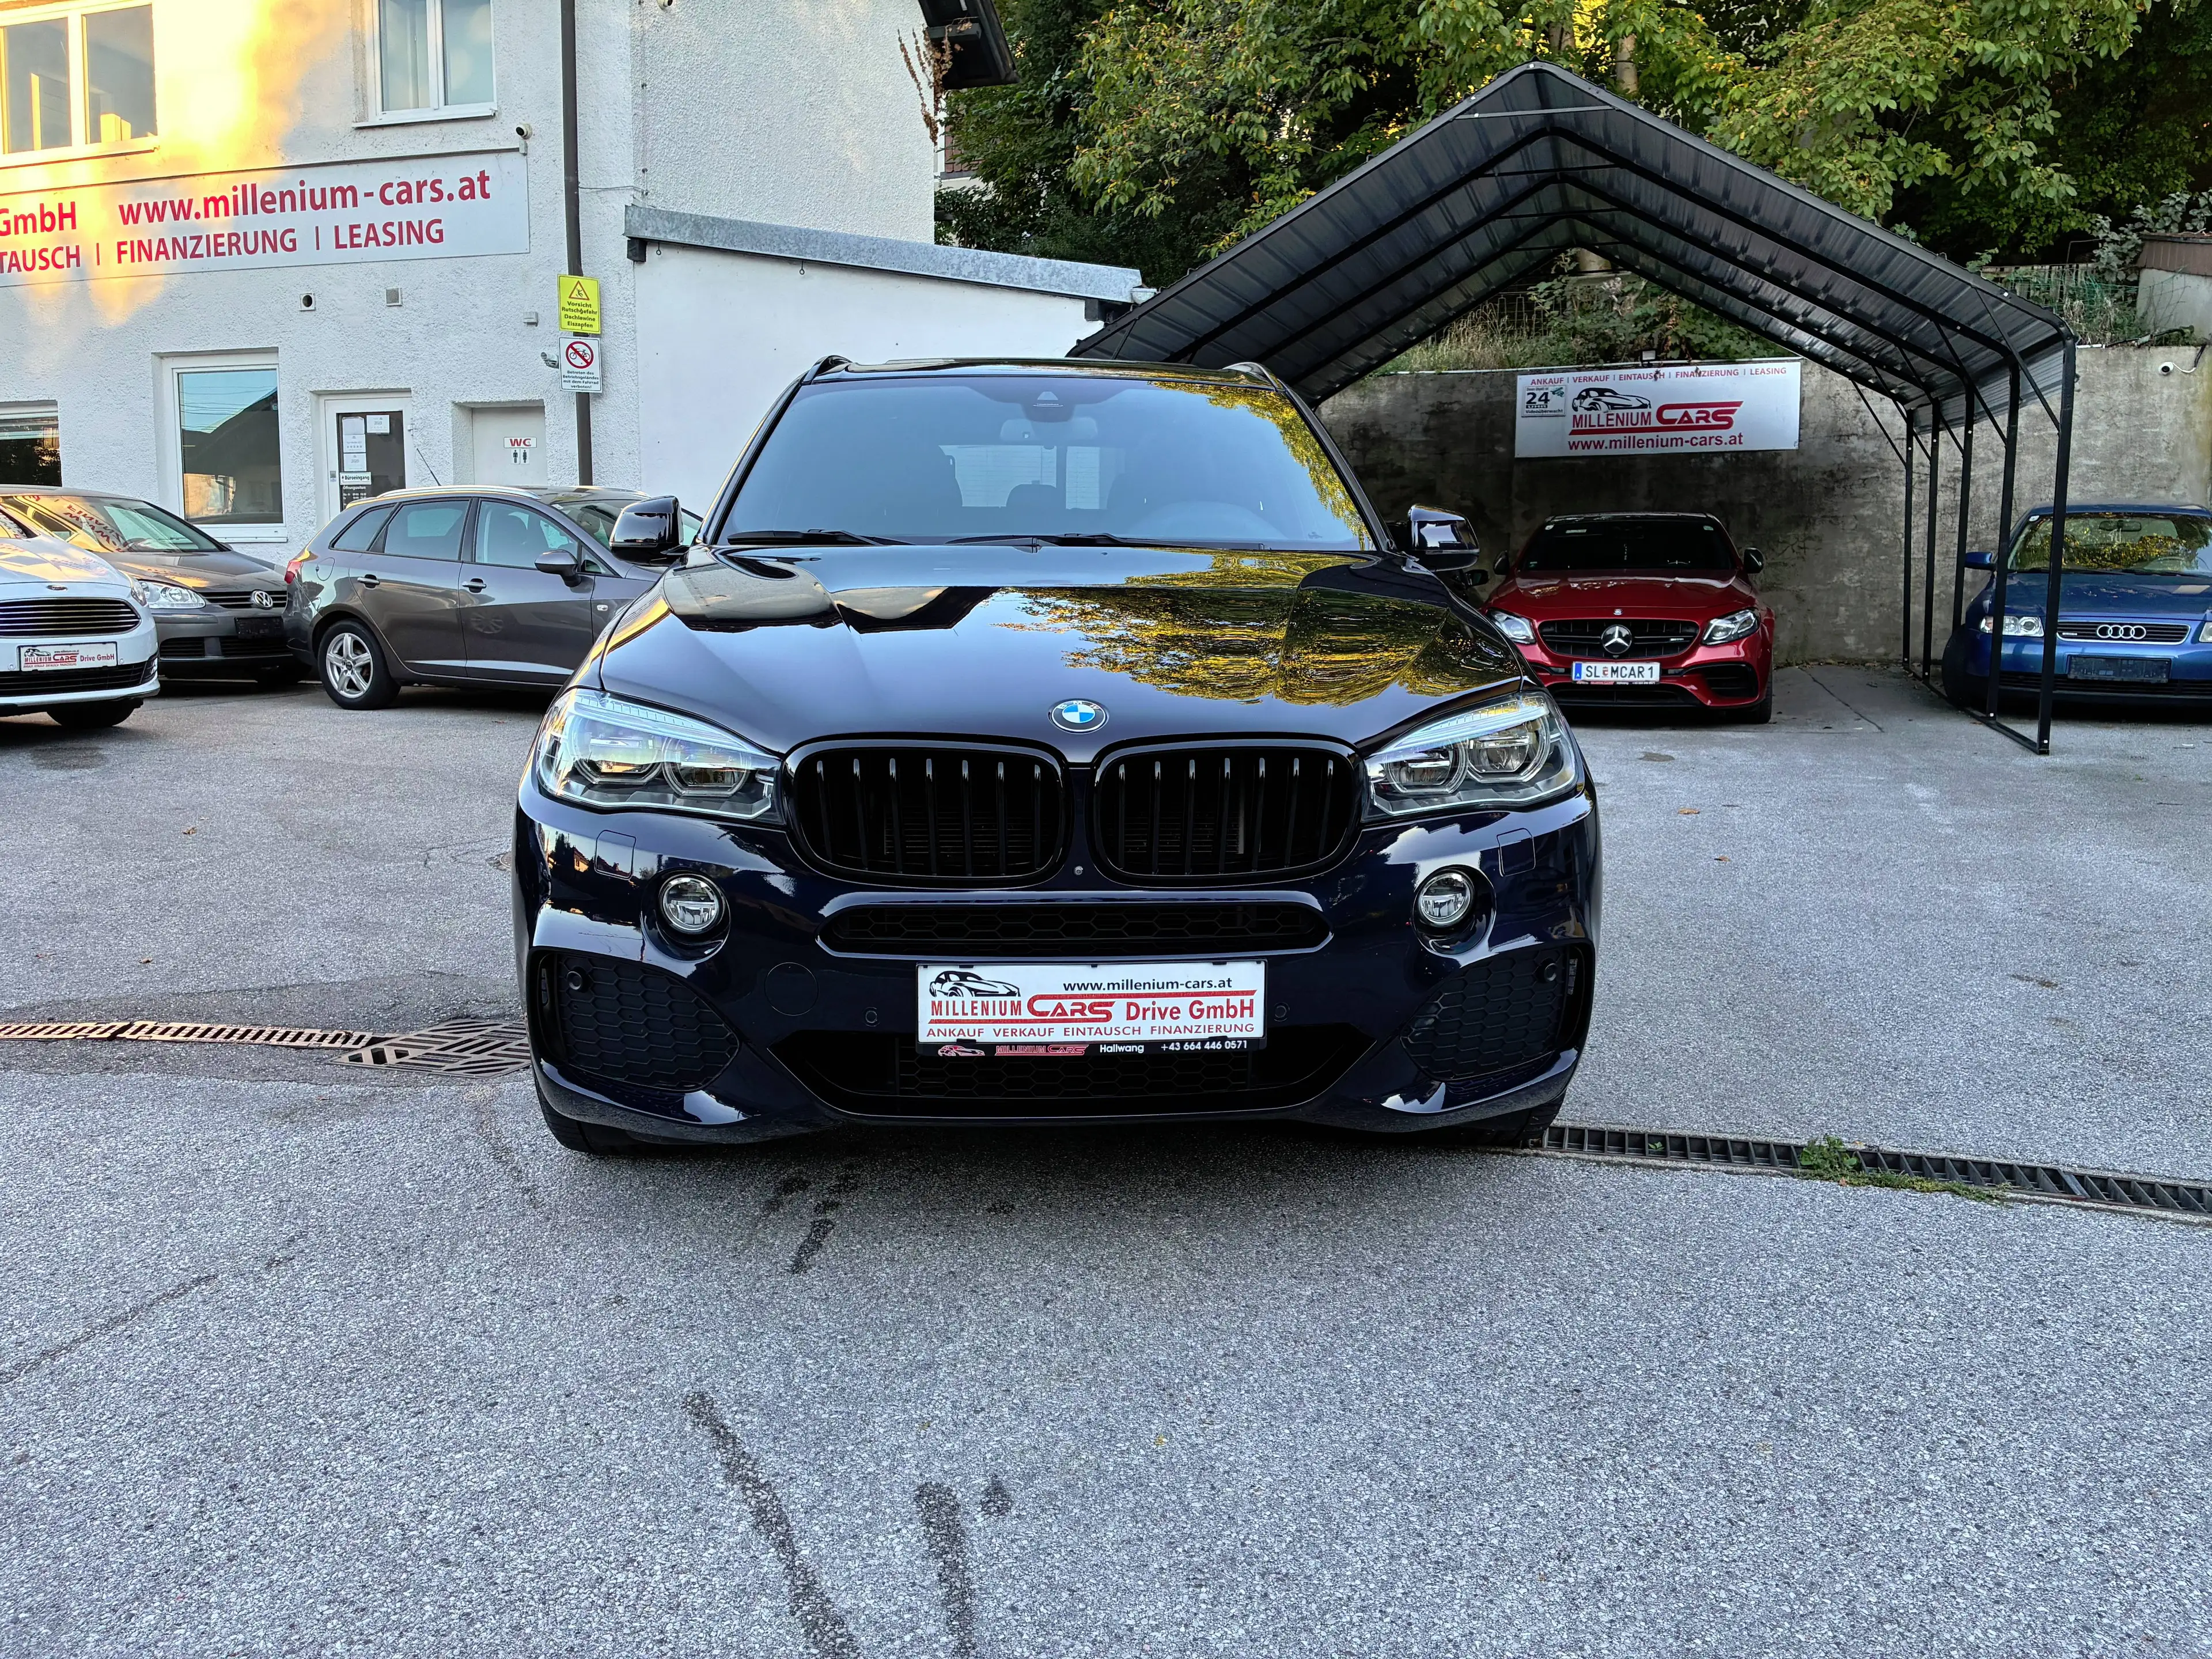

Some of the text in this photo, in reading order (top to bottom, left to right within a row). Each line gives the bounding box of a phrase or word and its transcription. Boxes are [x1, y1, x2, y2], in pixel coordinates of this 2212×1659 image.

[0, 169, 491, 236] GmbH www.millenium-cars.at
[117, 228, 297, 264] FINANZIERUNG
[334, 218, 444, 249] LEASING
[562, 306, 597, 315] Rutschgefahr
[567, 321, 593, 329] Eiszapfen
[1531, 377, 1564, 385] ANKAUF
[1573, 375, 1610, 383] VERKAUF
[1750, 367, 1786, 376] LEASING
[1526, 392, 1550, 404] 24
[1572, 400, 1744, 430] MILLENIUM CARS
[509, 438, 532, 446] WC
[1568, 432, 1743, 450] www.millenium-cars.at
[1586, 665, 1600, 677] SL
[1611, 666, 1645, 678] MCAR
[1063, 978, 1232, 991] www.millenium-cars.at
[931, 993, 1254, 1022] MILLENIUM CARS Drive GmbH
[926, 1023, 1255, 1037] ANKAUF VERKAUF EINTAUSCH FINANZIERUNG
[995, 1045, 1046, 1054] MILLENIUM
[1100, 1044, 1144, 1054] Hallwang
[1161, 1042, 1180, 1051] +43
[1183, 1041, 1202, 1051] 664
[1204, 1041, 1222, 1050] 446
[1224, 1040, 1247, 1049] 0571
